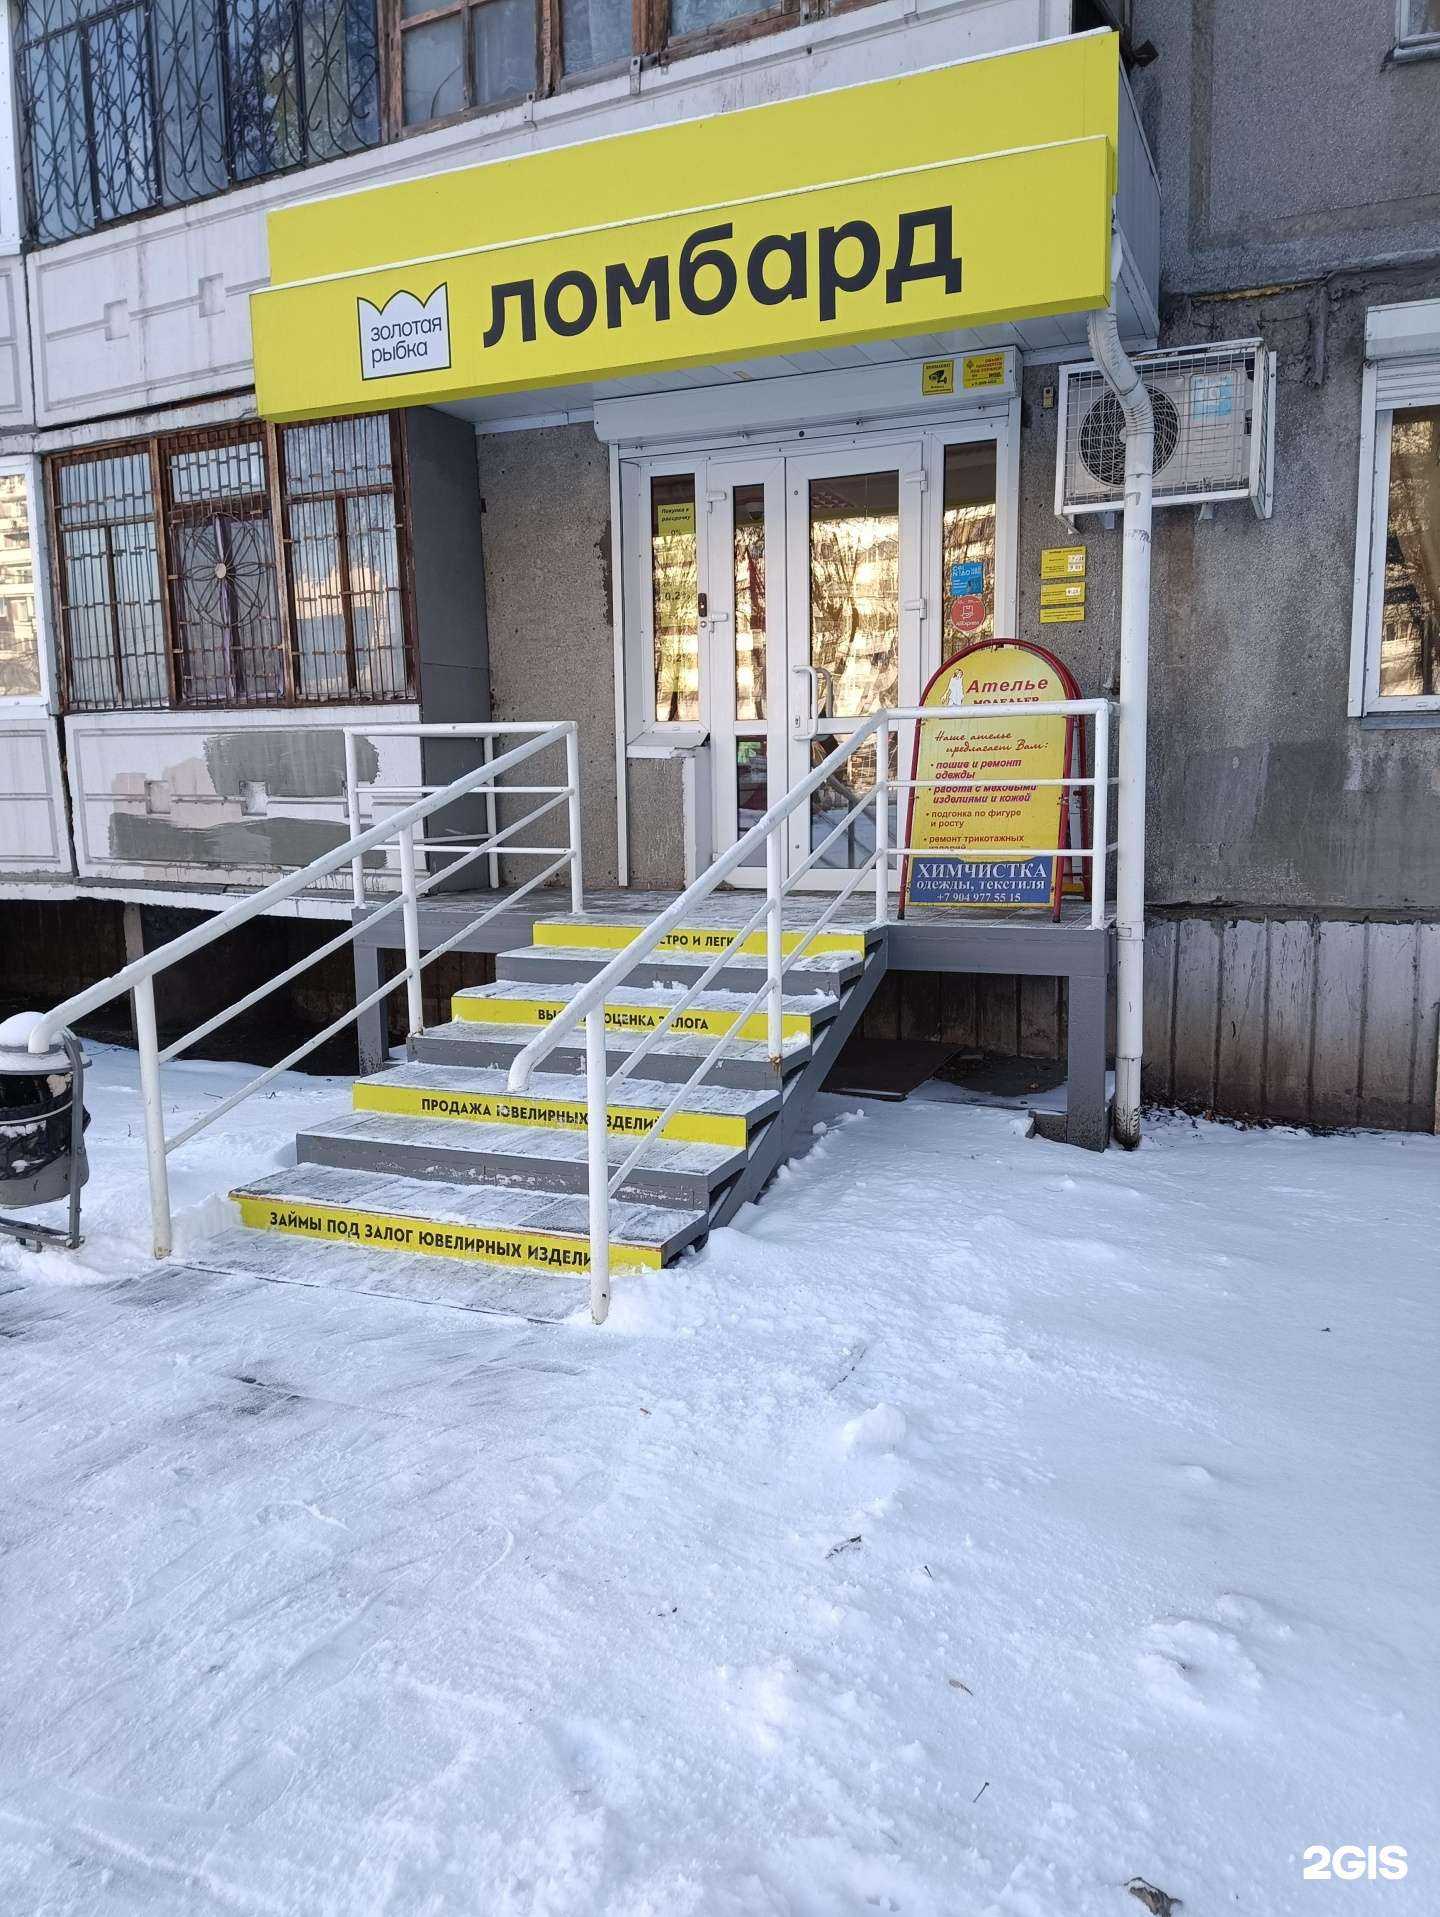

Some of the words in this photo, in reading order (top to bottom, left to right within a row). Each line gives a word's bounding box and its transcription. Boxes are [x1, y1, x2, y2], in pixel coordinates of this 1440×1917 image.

[483, 204, 964, 348] ломбард
[370, 317, 442, 342] золотая
[371, 340, 428, 368] рыбка
[966, 678, 1048, 694] Ателье
[935, 730, 966, 742] Наше
[970, 731, 1012, 741] ателье
[946, 741, 1012, 757] предлагает
[935, 761, 970, 770] пошив
[972, 760, 979, 769] и
[980, 759, 1022, 771] ремонт
[935, 770, 976, 780] одежды
[932, 795, 988, 804] изделиями
[990, 795, 997, 803] и
[999, 793, 1031, 803] кожей
[931, 810, 972, 819] подгонка
[988, 808, 1022, 818] фигуре
[938, 820, 964, 829] росту
[928, 835, 962, 844] ремонт
[964, 834, 1024, 844] трикотажных
[917, 863, 1047, 878] ХИМЧИСТКА
[916, 880, 975, 891] одежды,
[980, 880, 1045, 890] текстиля
[937, 892, 950, 902] +7
[953, 892, 970, 902] 904
[973, 892, 991, 902] 977
[994, 892, 1006, 902] 55
[1010, 892, 1021, 902] 15
[692, 935, 701, 946] И
[705, 936, 744, 947] ЛЕГК
[604, 1012, 655, 1028] ОЦЕНКА
[658, 1016, 709, 1030] ЗЛОГА
[421, 1098, 492, 1116] ПРОДАЖА
[496, 1104, 588, 1125] ЮВЕЛИРНЫХ
[606, 1114, 665, 1133] ЗДЕЛИ
[269, 1211, 322, 1231] ЗАЙМЫ
[327, 1219, 360, 1238] ПОД
[365, 1223, 413, 1243] ЗАЛОГ
[418, 1230, 522, 1258] ЮВЕЛИРНЫХ
[527, 1244, 591, 1267] ИЗДЕЛИ
